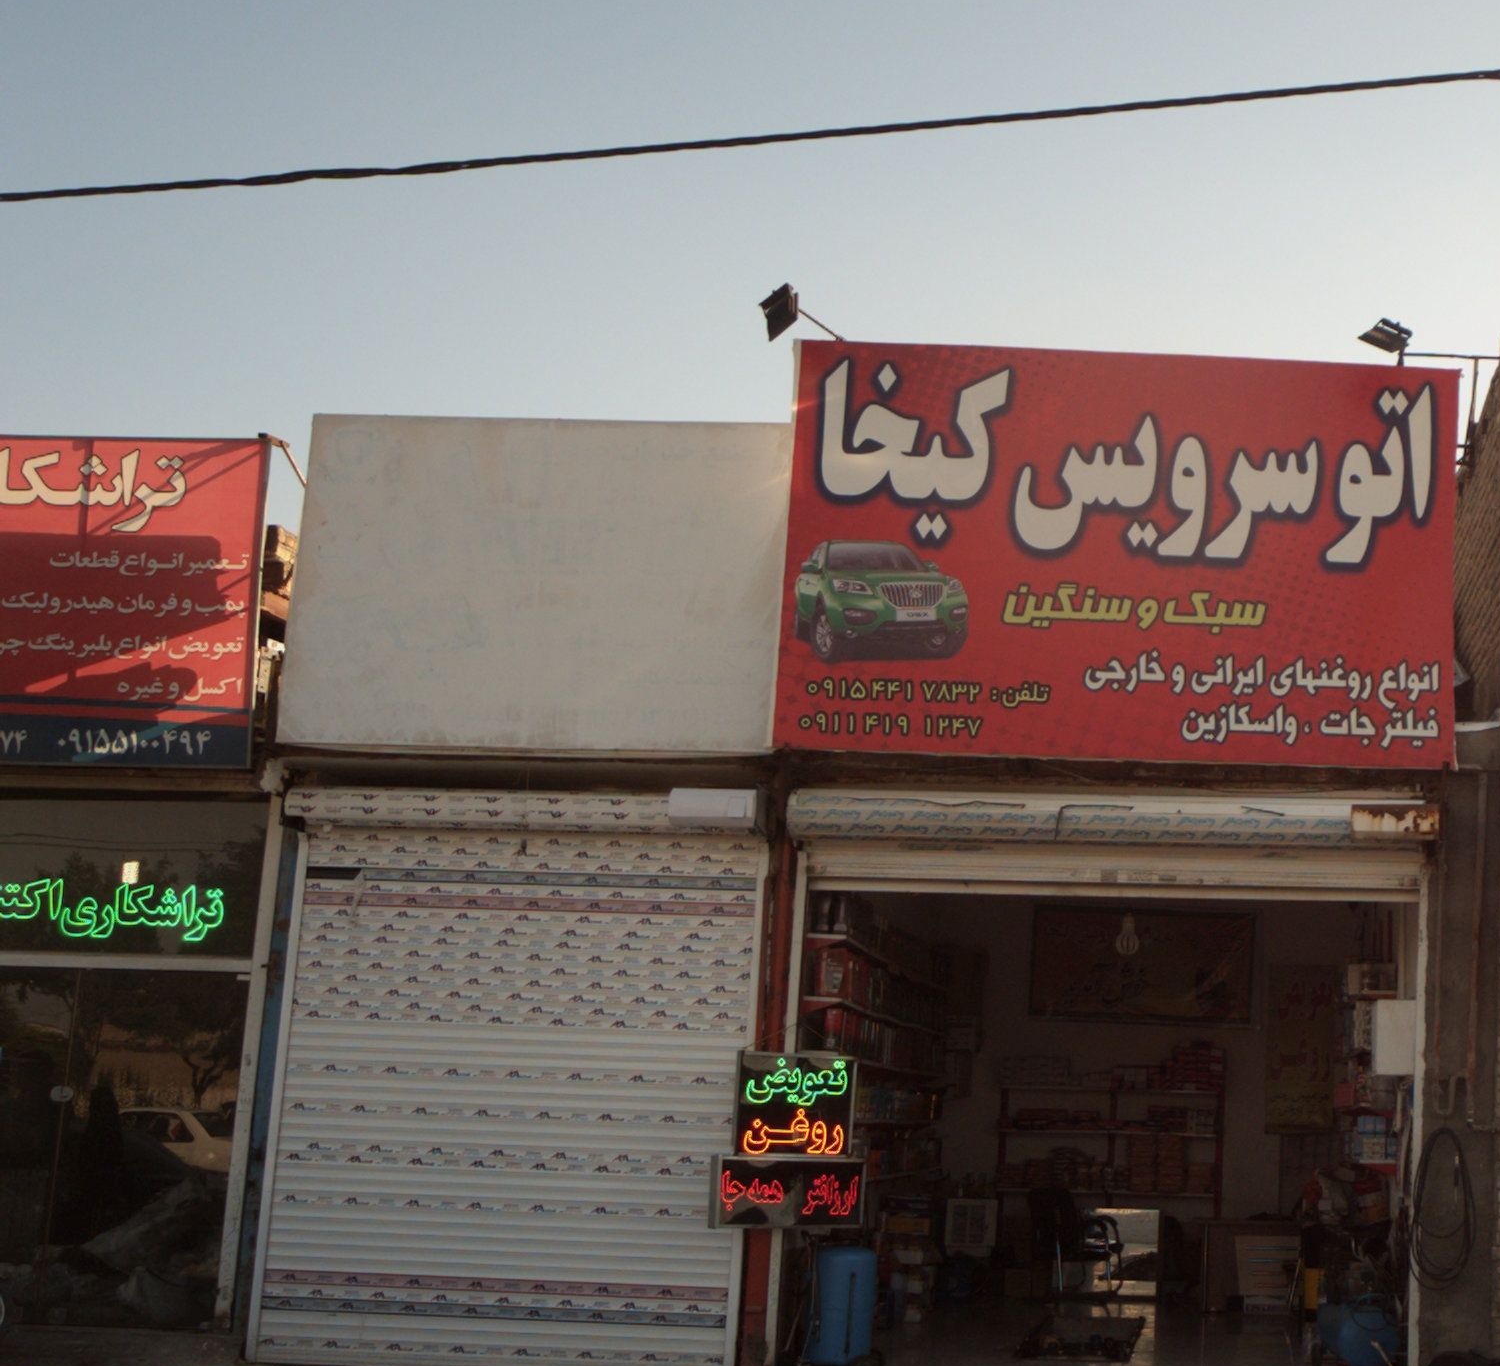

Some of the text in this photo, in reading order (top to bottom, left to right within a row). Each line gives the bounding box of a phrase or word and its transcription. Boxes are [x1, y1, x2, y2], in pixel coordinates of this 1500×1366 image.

[820, 358, 1434, 565] اتو سرویس کیخا
[49, 549, 250, 578] تعمیر انواع قطعات
[2, 591, 114, 615] هیدرولیک
[117, 593, 177, 617] فرمان
[181, 599, 192, 616] و
[1002, 583, 1267, 631] سبک و سنگین
[28, 632, 113, 658] بلبرینگ
[113, 633, 168, 660] انواع
[168, 635, 244, 661] تعویض
[116, 676, 163, 700] غیره
[168, 681, 181, 699] و
[1085, 649, 1440, 709] انواع روغنهای ایرانی و خارجی
[1181, 702, 1299, 746] واسکازین
[60, 883, 225, 942] تراشکاری
[745, 1057, 848, 1106] تعویض
[743, 1107, 845, 1155] روغن
[720, 1169, 747, 1212] جا
[747, 1178, 785, 1204] همه
